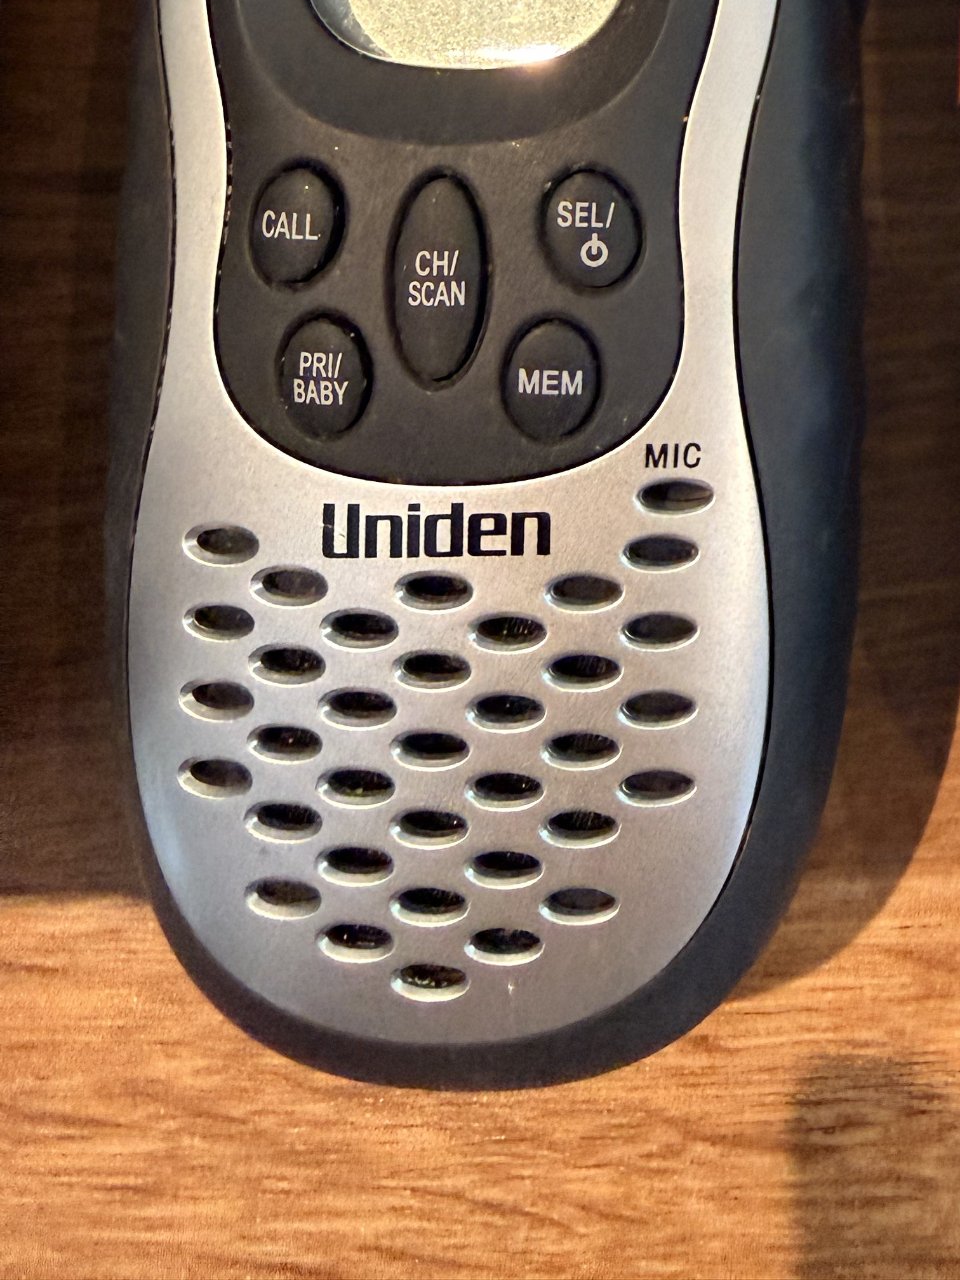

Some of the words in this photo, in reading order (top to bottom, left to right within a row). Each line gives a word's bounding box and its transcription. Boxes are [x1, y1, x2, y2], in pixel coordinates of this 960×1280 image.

[261, 209, 319, 241] CALL
[557, 201, 616, 228] SEL/
[414, 249, 460, 277] CH/
[407, 280, 466, 307] SCAN
[299, 351, 344, 380] PRI/
[292, 379, 349, 407] BABY
[517, 368, 583, 397] MEM
[644, 442, 703, 469] MIC
[322, 502, 552, 560] Uniden
